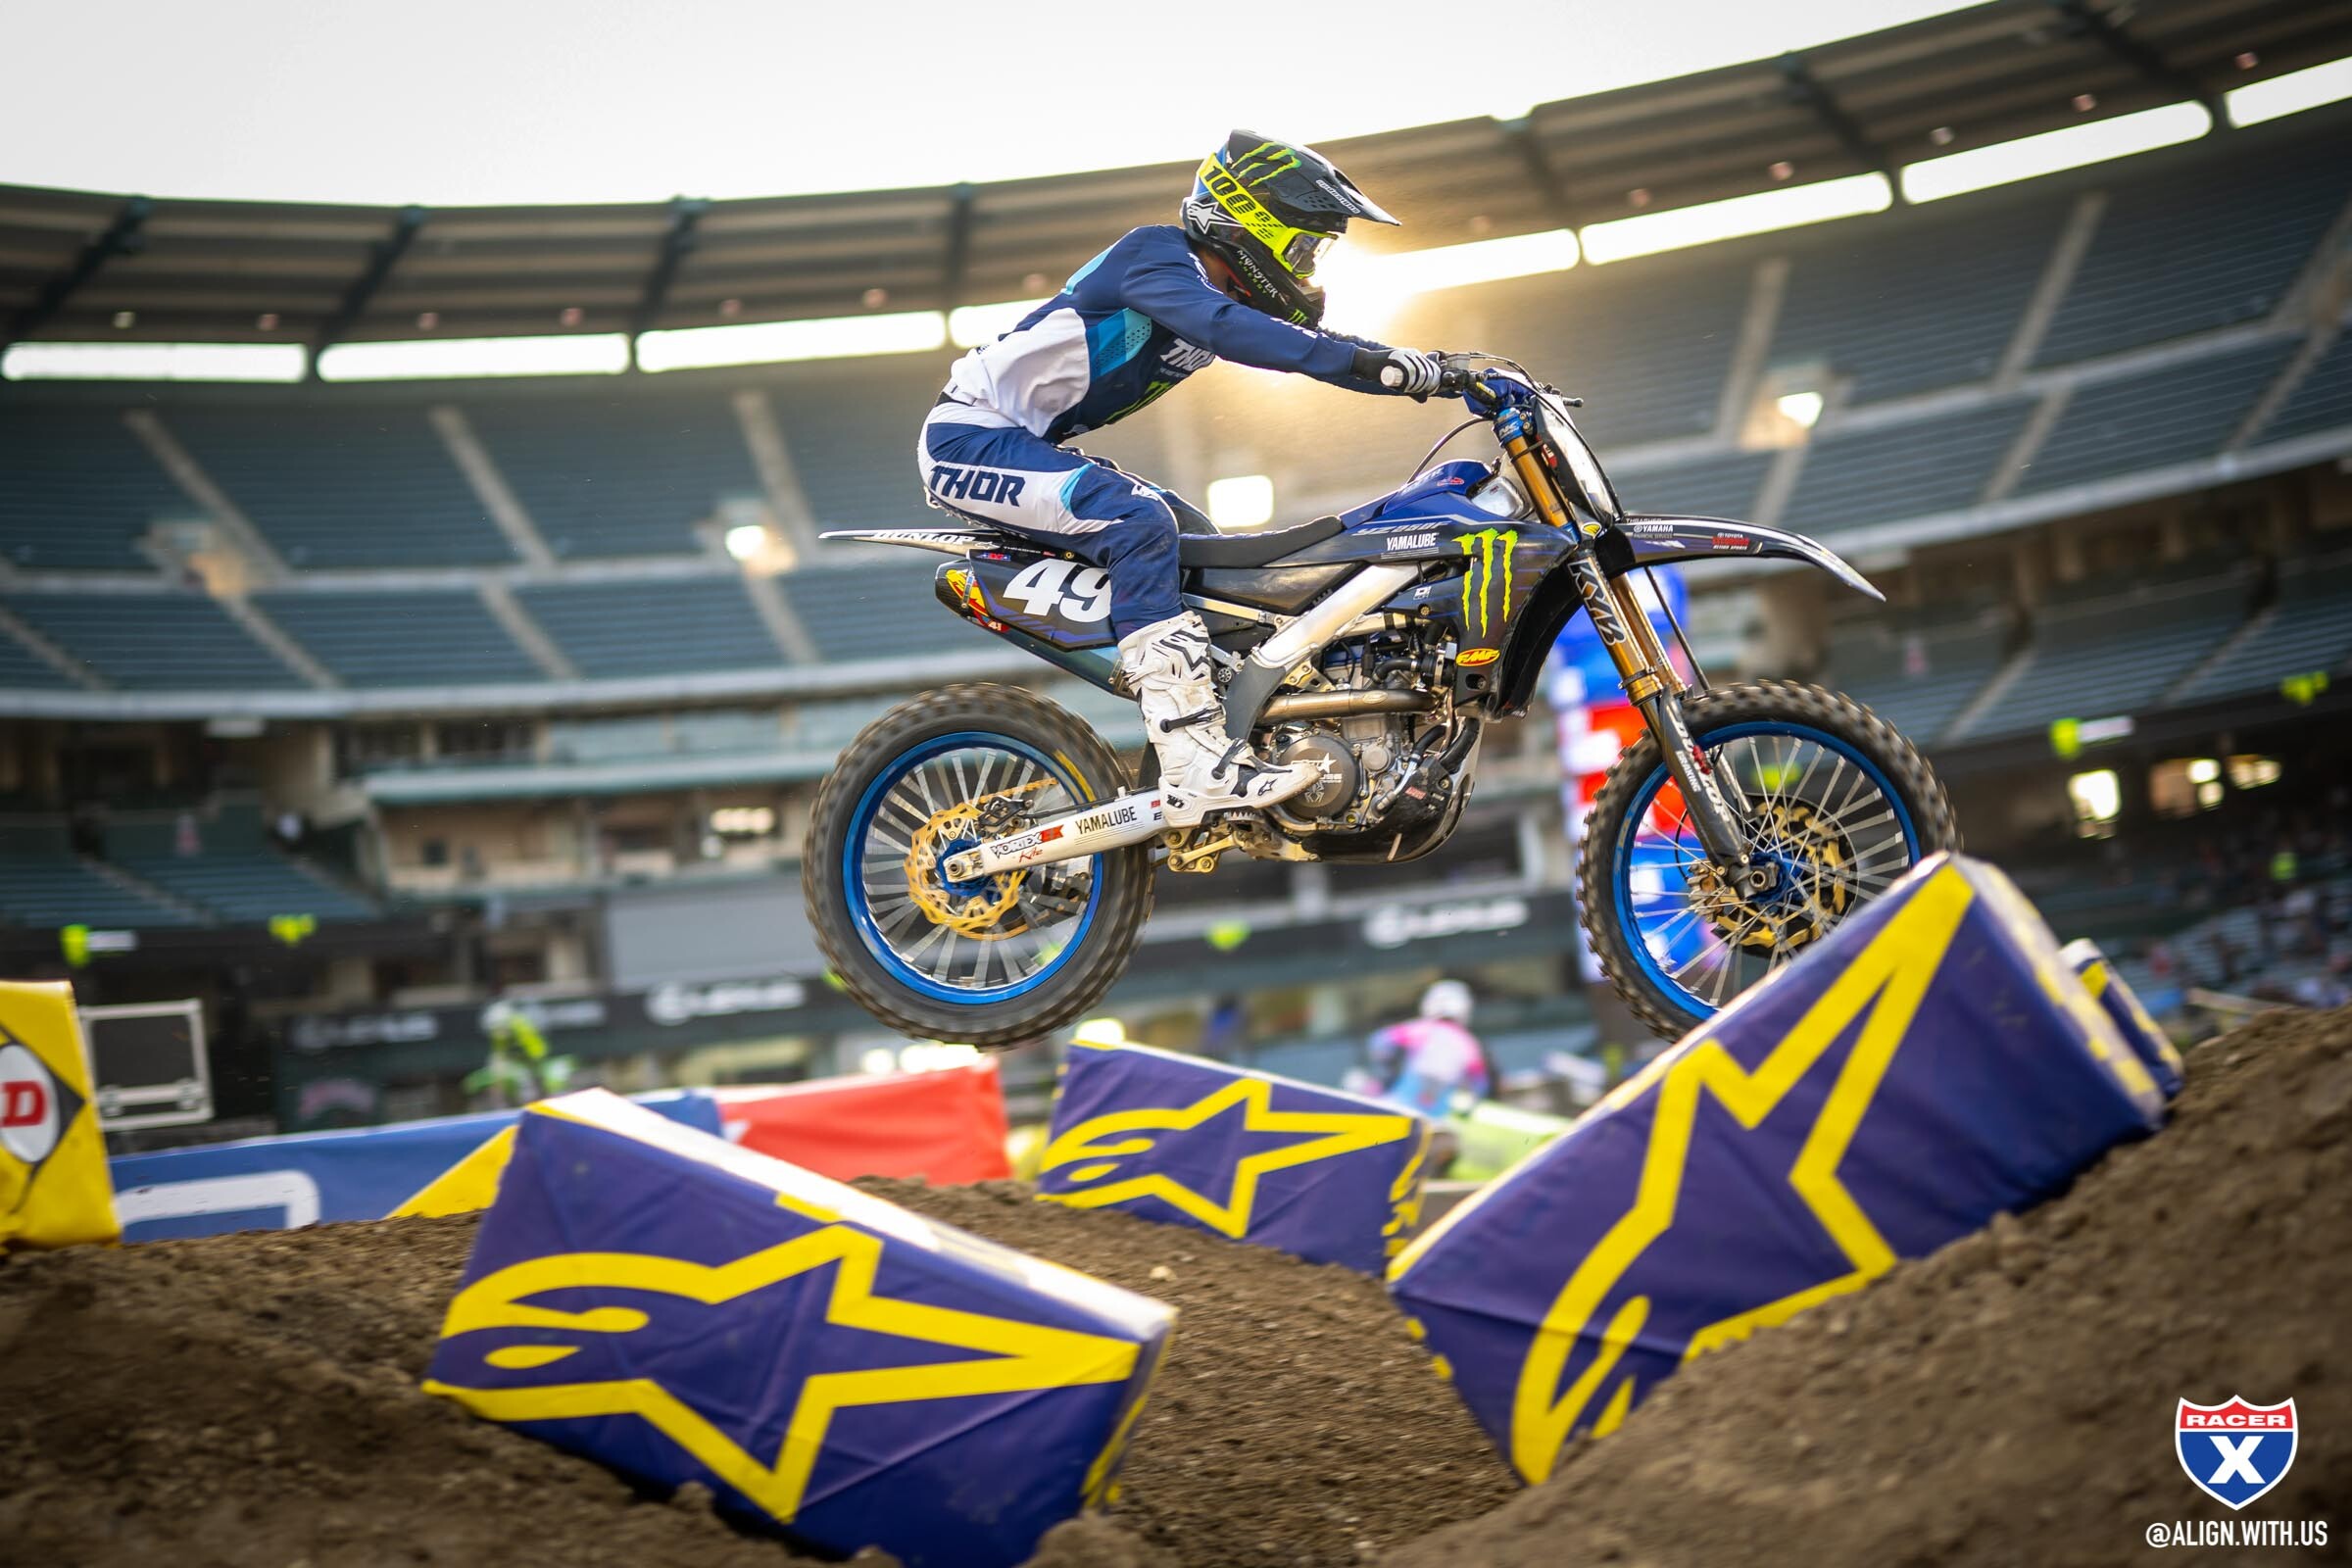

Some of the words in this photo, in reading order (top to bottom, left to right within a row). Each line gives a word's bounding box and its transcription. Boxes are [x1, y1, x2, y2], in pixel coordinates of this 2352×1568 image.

[1160, 337, 1216, 372] THO
[930, 465, 1026, 508] THOR
[872, 530, 976, 546] DUNLOP
[1387, 532, 1437, 552] YAMALUBE
[1642, 524, 1674, 533] YAMAHA
[1003, 558, 1111, 623] 49
[1567, 556, 1627, 646] KYB
[1457, 651, 1499, 665] FMF
[1675, 750, 1702, 793] BRAKING
[1075, 806, 1138, 835] YAMALUBE
[990, 831, 1044, 858] VORTEX
